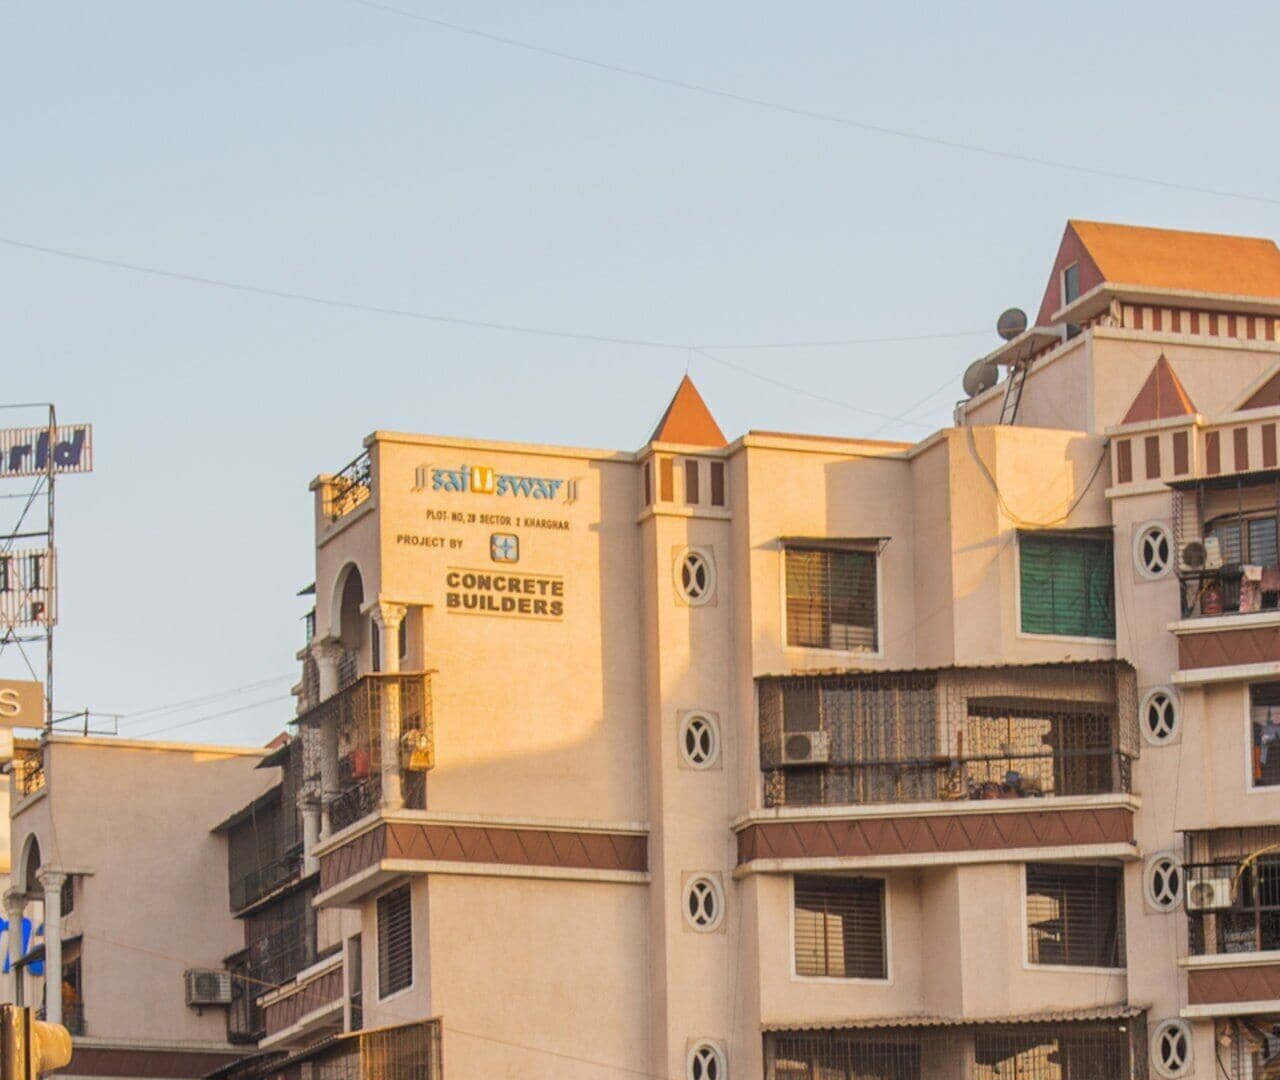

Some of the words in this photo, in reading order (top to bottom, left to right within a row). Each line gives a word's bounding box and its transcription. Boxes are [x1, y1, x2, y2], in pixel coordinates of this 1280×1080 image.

[426, 509, 448, 522] PLOT
[479, 513, 512, 527] SECTOR
[515, 517, 521, 527] 2
[524, 519, 570, 531] KHARGHAR
[396, 534, 445, 549] PROJECT
[450, 538, 464, 549] BY
[446, 572, 564, 597] CONCRETE
[446, 593, 564, 617] BUILDERS
